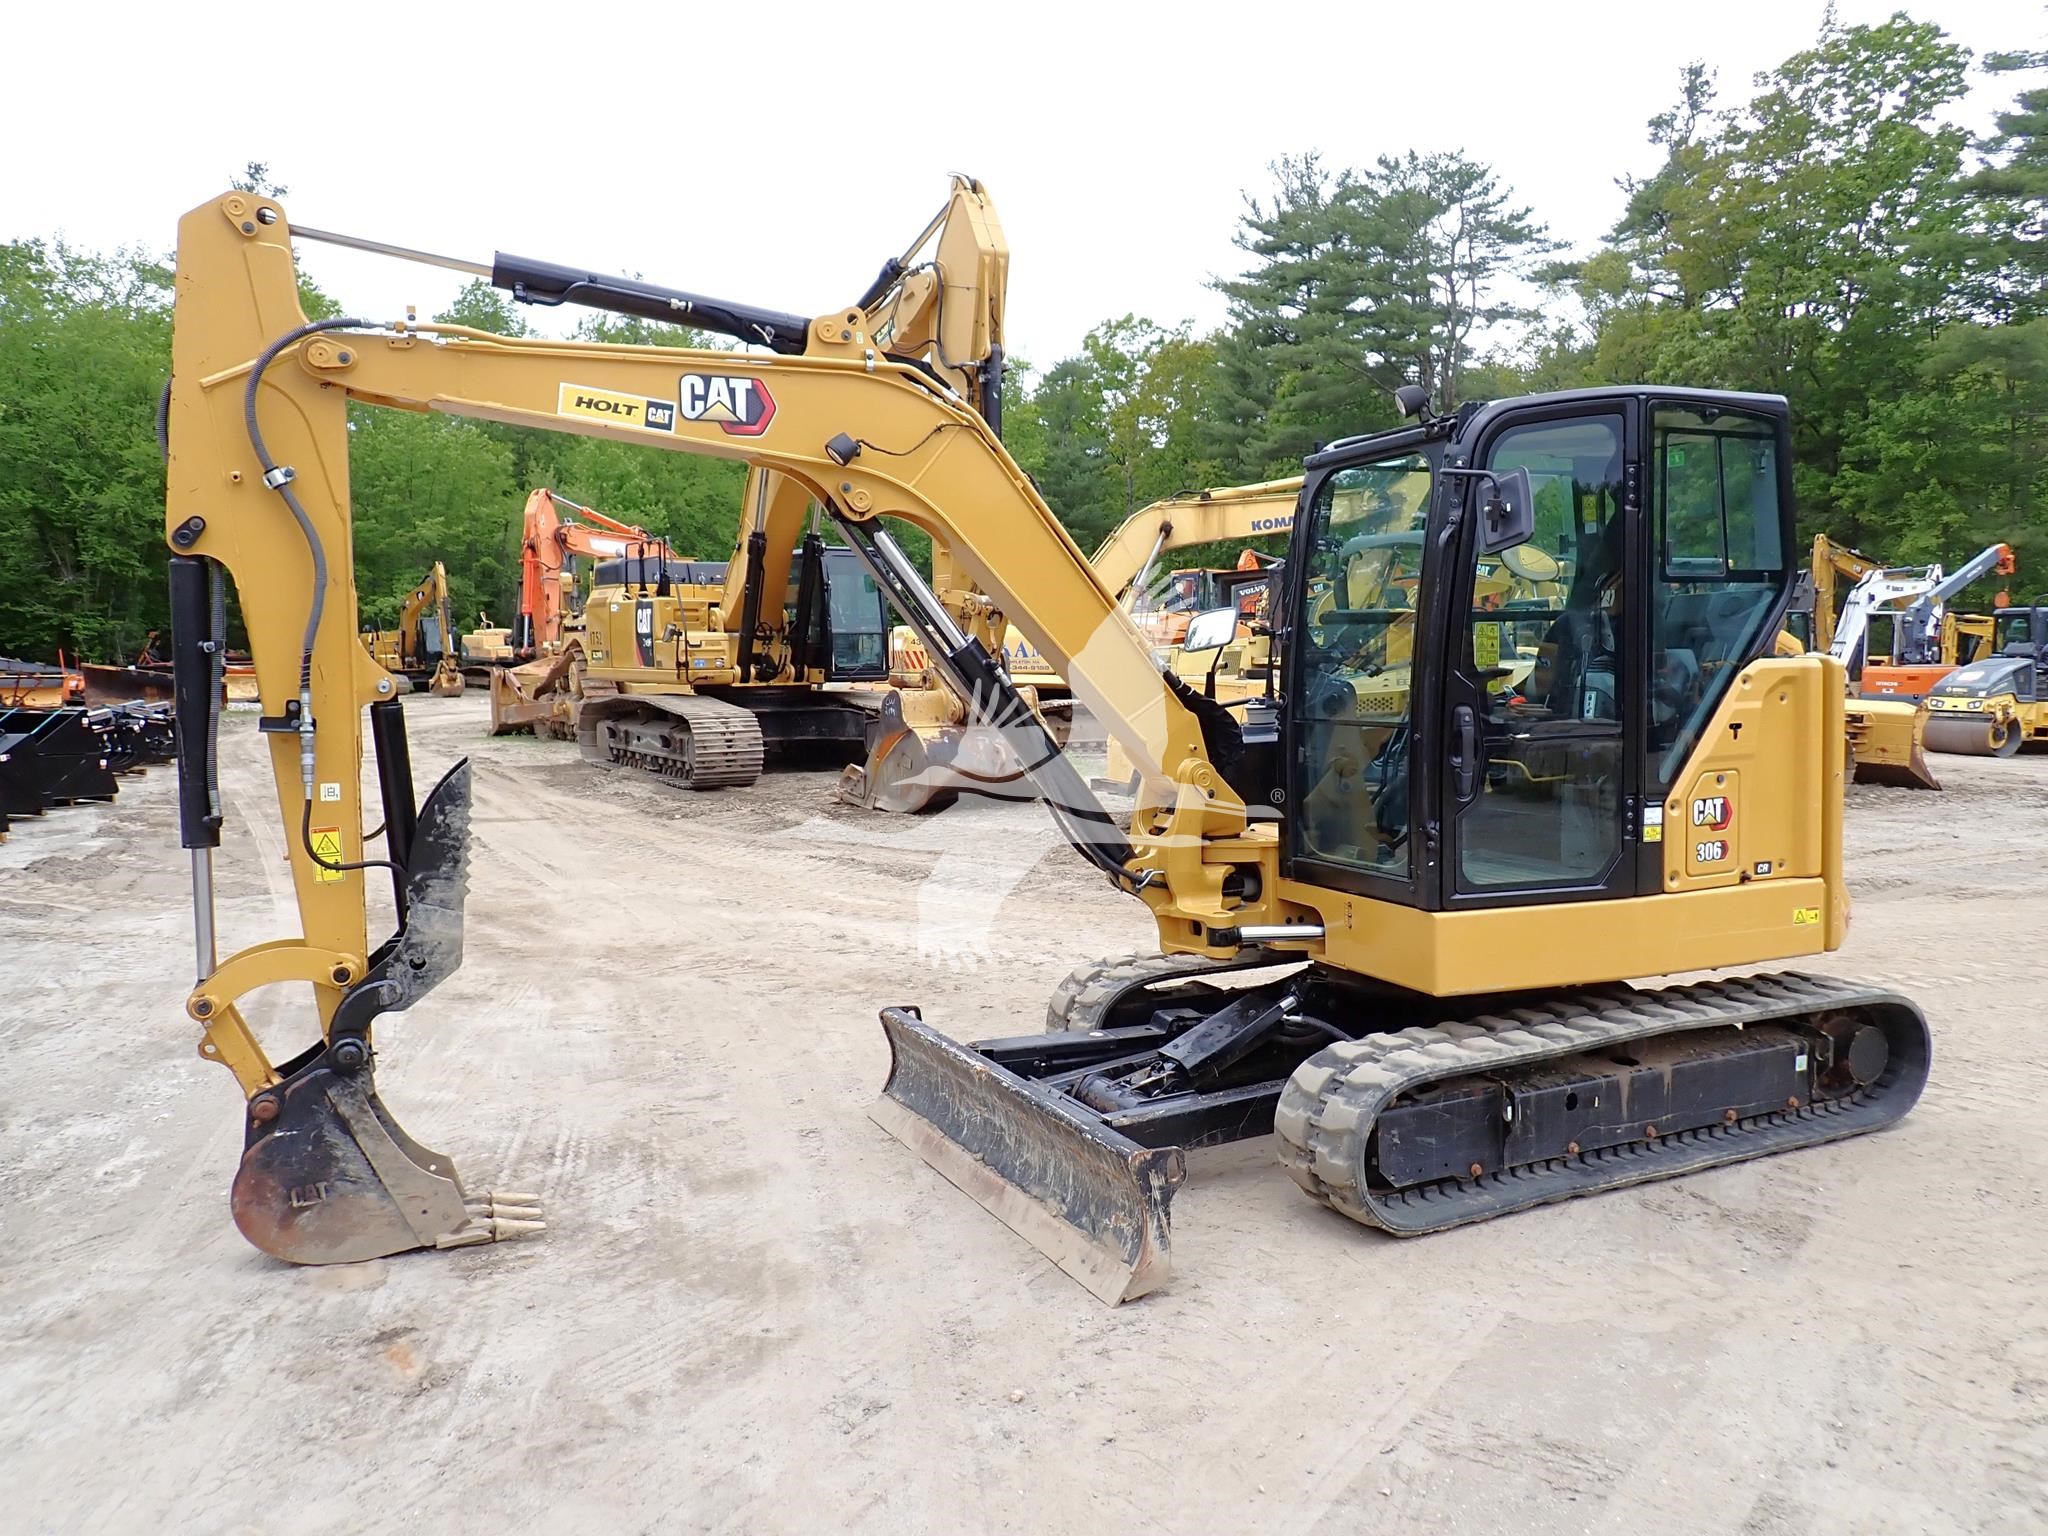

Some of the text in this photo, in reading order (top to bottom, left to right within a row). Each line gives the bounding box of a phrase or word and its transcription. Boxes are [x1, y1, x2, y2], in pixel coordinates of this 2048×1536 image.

[574, 395, 673, 425] HOLT CAT
[680, 374, 753, 423] CAT
[1239, 584, 1266, 596] VOLVO
[636, 608, 652, 634] CAT
[1693, 797, 1724, 826] CAT
[1696, 841, 1722, 862] 306
[1757, 863, 1769, 873] CR
[291, 1181, 328, 1208] CAT
